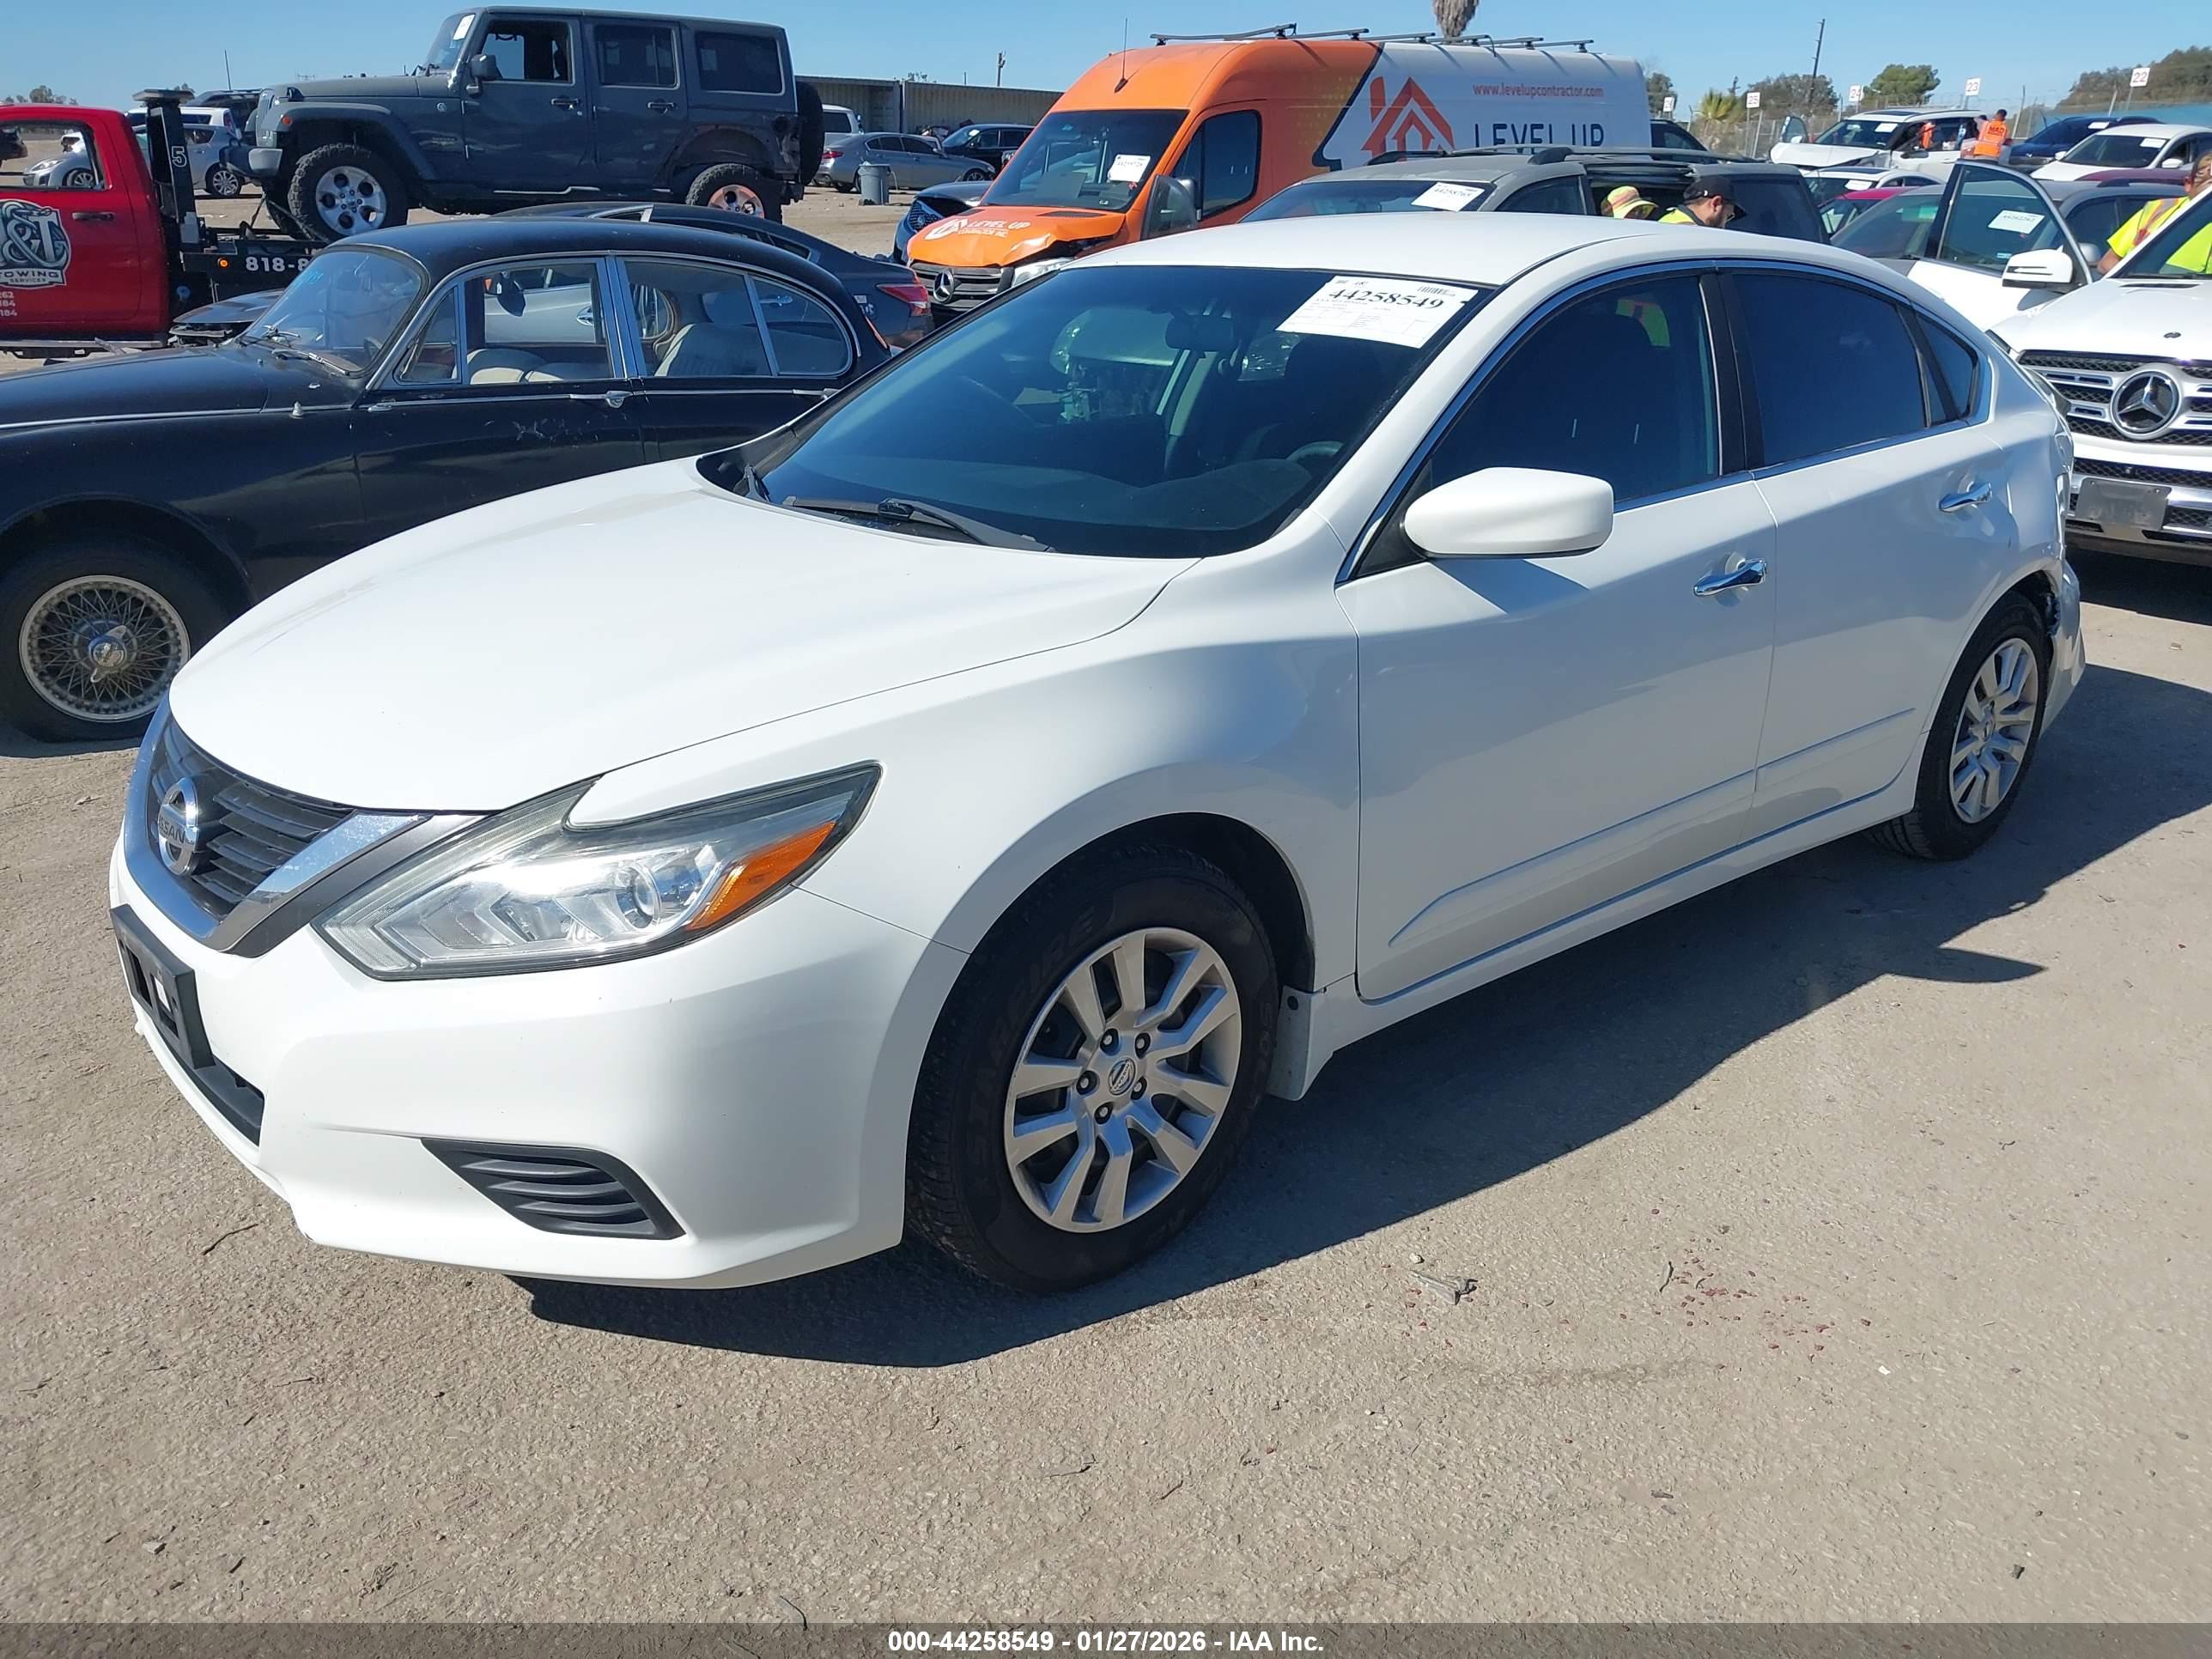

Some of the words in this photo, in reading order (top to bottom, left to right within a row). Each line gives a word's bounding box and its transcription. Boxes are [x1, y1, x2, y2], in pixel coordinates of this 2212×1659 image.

[2133, 71, 2146, 82] 22
[1473, 82, 1604, 99] www.levelupcontractor.com
[1966, 82, 1978, 92] 23
[1748, 94, 1759, 105] 25
[172, 146, 187, 167] 5
[1329, 289, 1445, 309] 44258549
